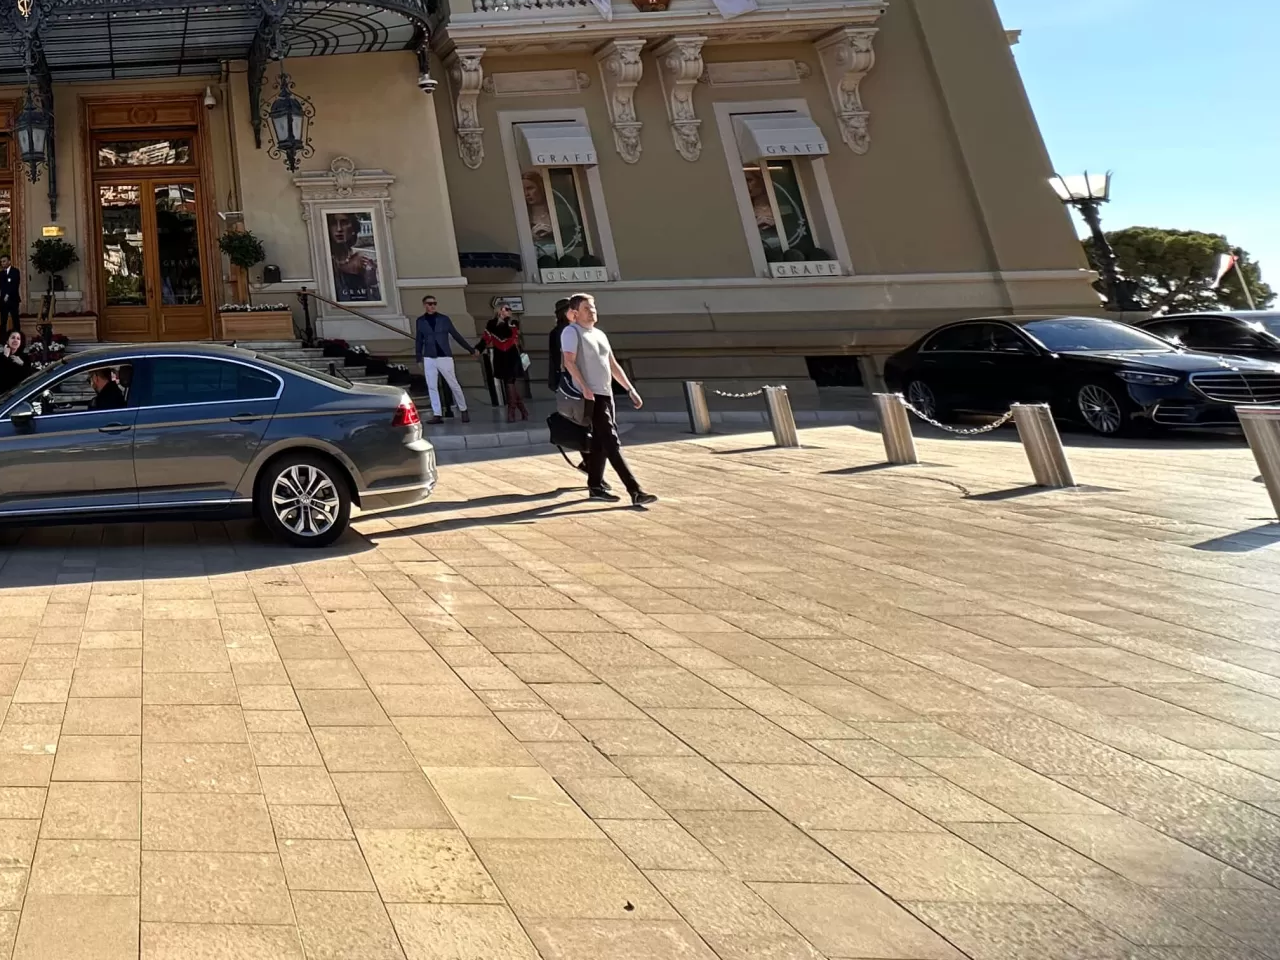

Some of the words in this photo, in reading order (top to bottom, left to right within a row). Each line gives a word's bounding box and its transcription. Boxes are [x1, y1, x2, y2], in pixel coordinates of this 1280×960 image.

[766, 143, 825, 154] GRAFF
[537, 153, 593, 164] GRAFF
[776, 263, 838, 275] GRAFF
[546, 270, 603, 281] GRAFF
